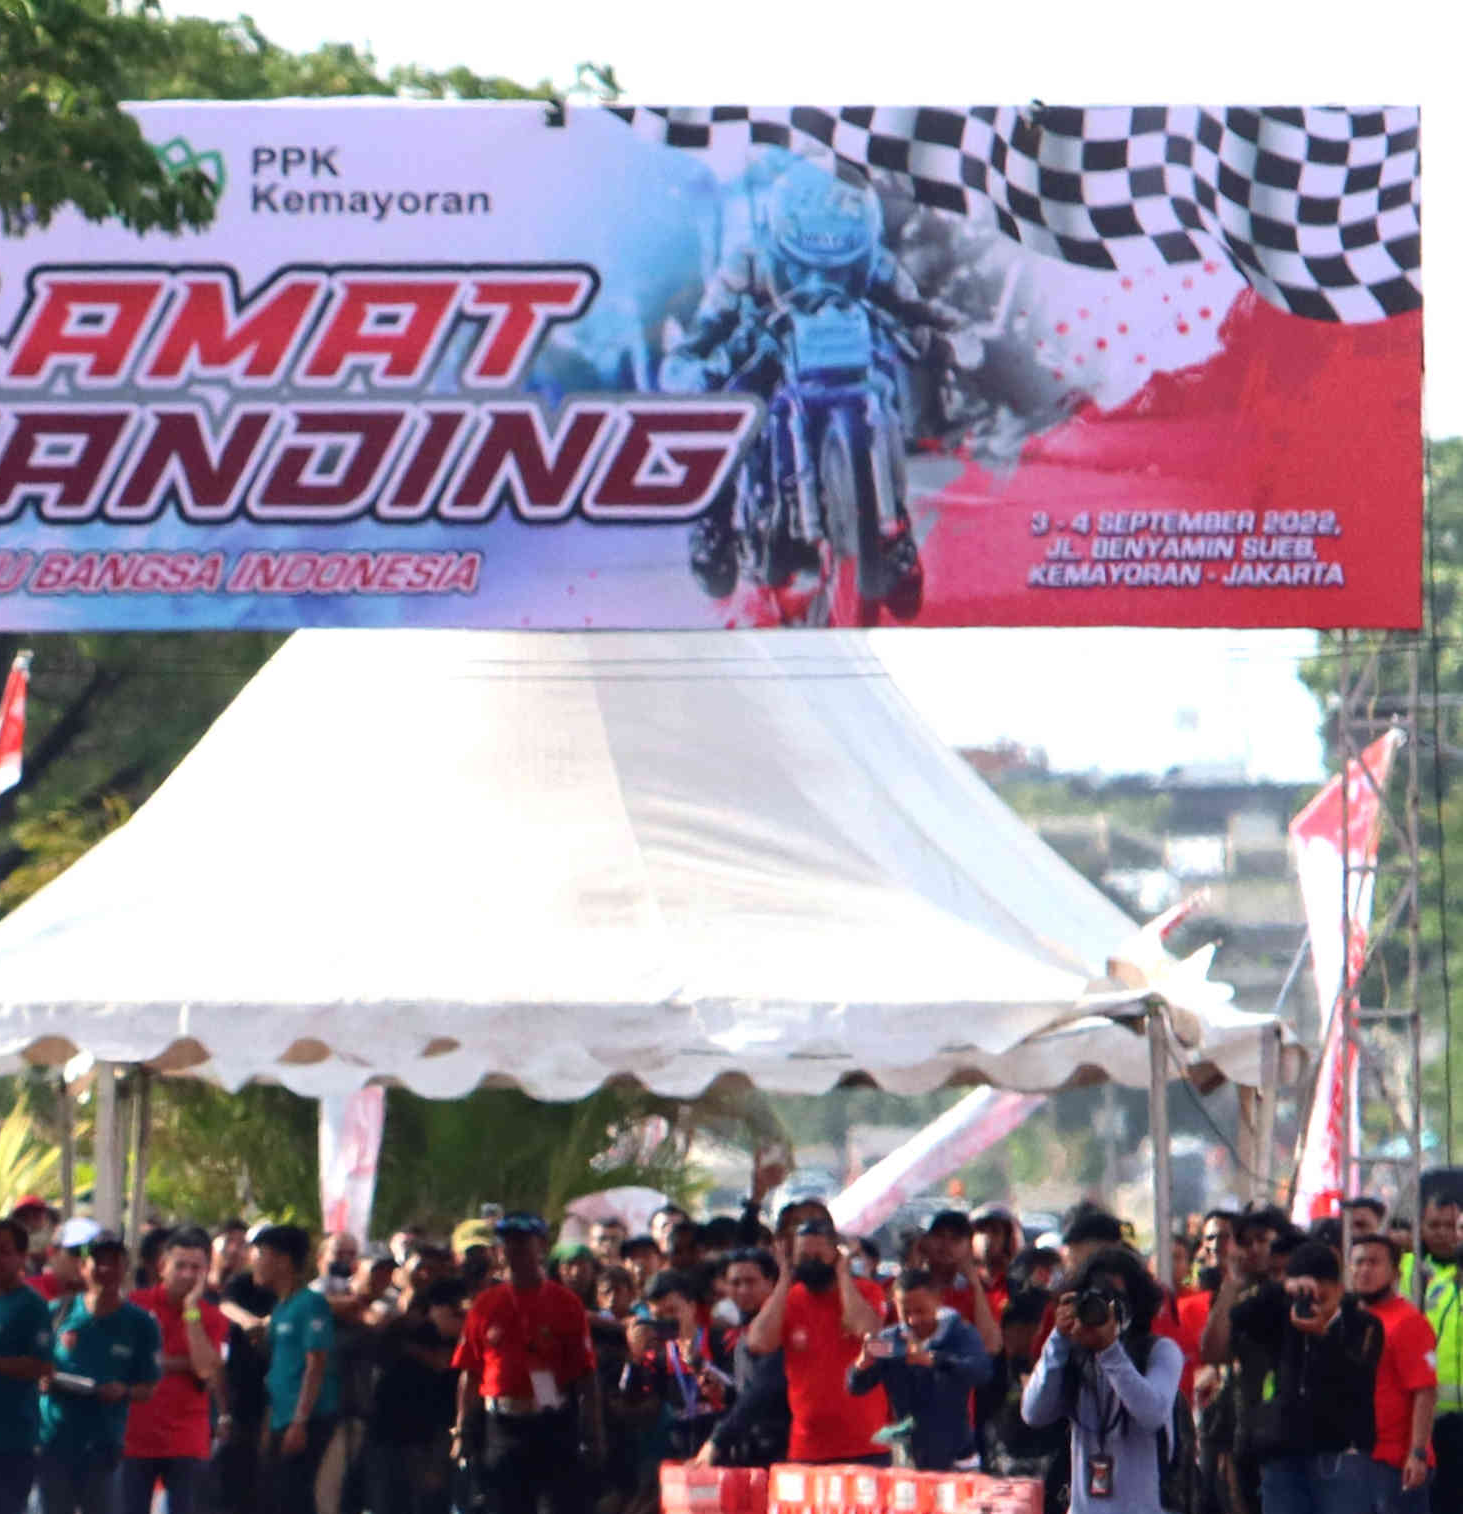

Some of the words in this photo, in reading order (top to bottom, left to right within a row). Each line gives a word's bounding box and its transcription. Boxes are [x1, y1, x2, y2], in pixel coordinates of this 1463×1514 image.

[251, 146, 340, 177] PPK
[250, 183, 491, 222] Kemayoran
[1030, 510, 1049, 535] 3
[1070, 510, 1091, 535] 4
[1096, 510, 1255, 535] SEPTEMBER
[1089, 537, 1235, 561] BENYAMIN
[28, 552, 223, 595] BANGSA
[226, 551, 482, 595] INDONESIA
[1026, 562, 1202, 587] KEMAYORAN
[1221, 562, 1345, 587] JAKARTA
